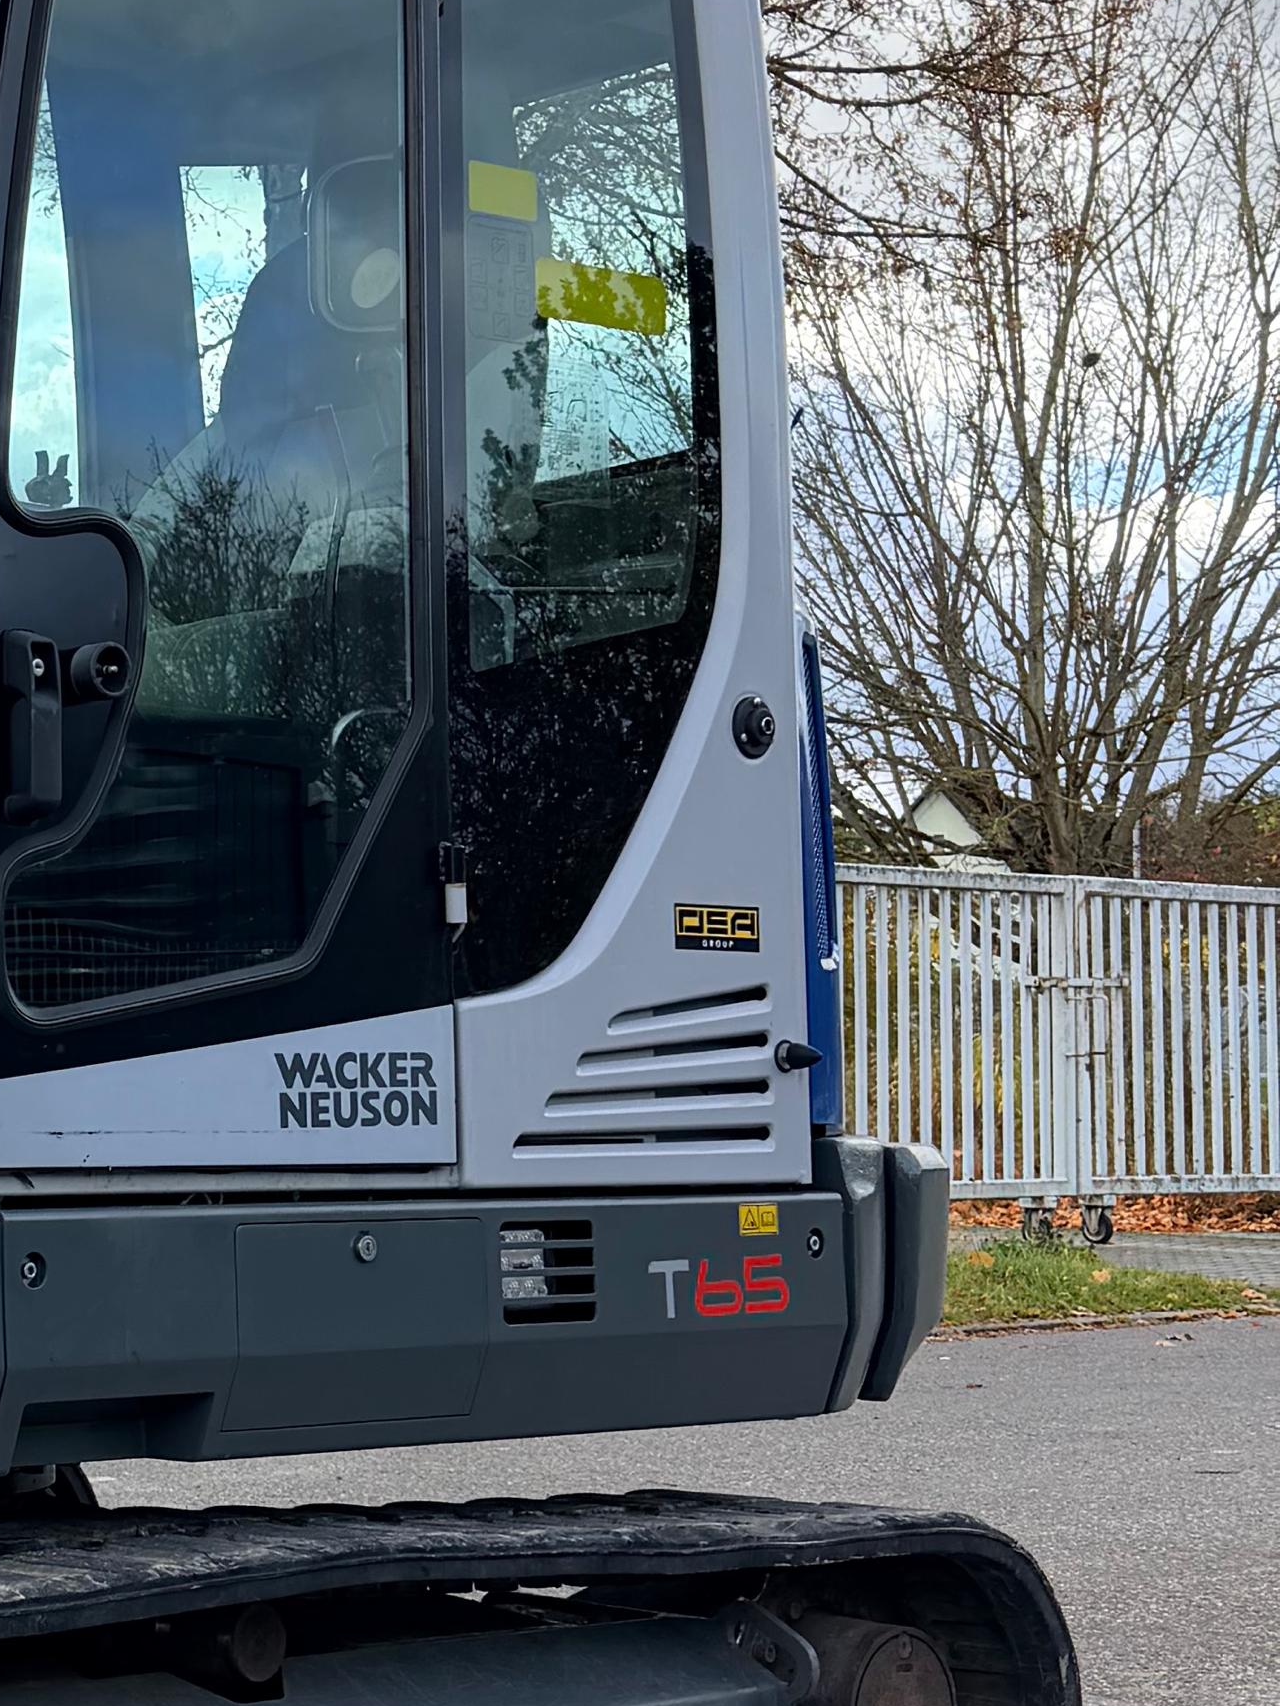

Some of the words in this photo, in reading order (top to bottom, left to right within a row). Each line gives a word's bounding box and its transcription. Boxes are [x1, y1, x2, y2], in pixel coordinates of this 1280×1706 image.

[702, 939, 734, 948] GROUP
[274, 1051, 437, 1089] WACKER
[279, 1090, 438, 1128] NEUSON
[647, 1253, 790, 1319] T65
